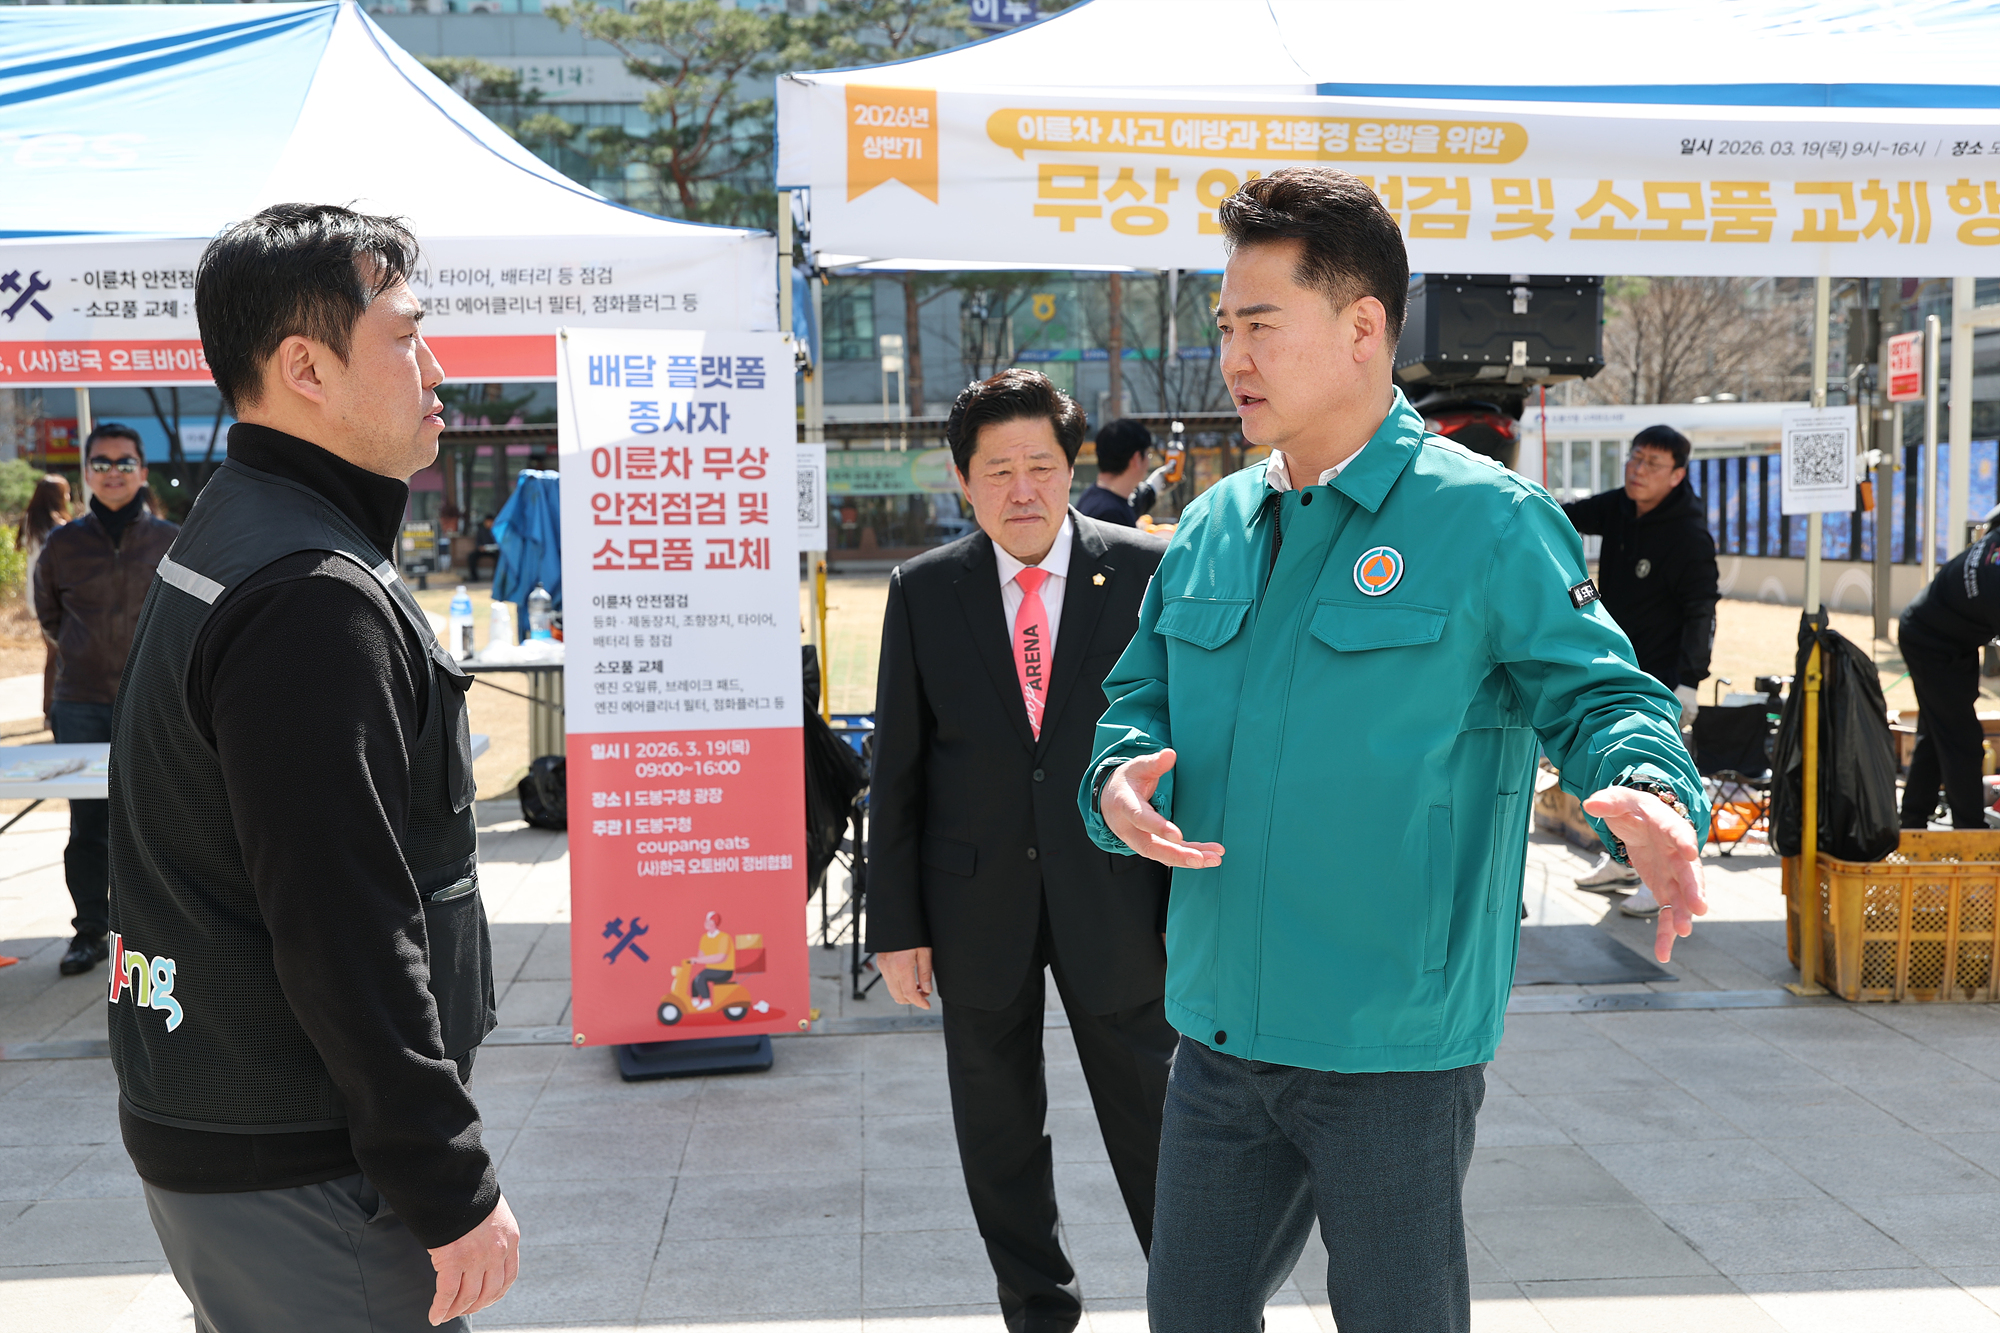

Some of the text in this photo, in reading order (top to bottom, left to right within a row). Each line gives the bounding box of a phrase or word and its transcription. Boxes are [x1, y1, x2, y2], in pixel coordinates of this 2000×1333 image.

[854, 104, 929, 128] 2026년
[1017, 115, 1505, 155] 이륜차 사고 예방과 친환경 운행을 위한
[862, 136, 922, 159] 상반기
[1681, 139, 1713, 155] 일시
[1718, 140, 1764, 155] 2026.
[1770, 141, 1795, 156] 03.
[1803, 141, 1847, 159] 19(목)
[1852, 141, 1926, 157] 9시~16시
[1953, 141, 1983, 156] 장소
[1034, 164, 1179, 236] 무상
[1491, 178, 1554, 241] 및
[1570, 180, 1777, 243] 소모품
[1792, 179, 1931, 243] 교체
[84, 271, 136, 289] 이륜차
[439, 269, 494, 287] 타이어,
[501, 268, 551, 285] 배터리
[557, 268, 572, 285] 등
[580, 267, 612, 285] 점검
[87, 301, 137, 318] 소모품
[144, 301, 177, 318] 교체
[456, 296, 541, 314] 에어클리너
[549, 296, 585, 315] 필터,
[593, 294, 676, 313] 점화플러그
[681, 294, 699, 312] 등
[19, 349, 102, 372] (사)한국
[589, 355, 766, 389] 배달 플랫폼
[629, 401, 730, 434] 종사자
[592, 447, 769, 480] 이륜차 무상
[591, 493, 768, 525] 안전점검 및
[593, 538, 770, 571] 소모품 교체
[593, 595, 688, 609] 이륜차 안전점검
[594, 616, 616, 628] 등화
[628, 615, 679, 628] 제동장치,
[684, 615, 734, 627] 조향장치,
[738, 614, 776, 626] 타이어,
[593, 635, 672, 648] 배터리 등 점검
[595, 660, 663, 674] 소모품 교체
[1023, 624, 1043, 692] ARENA
[595, 679, 743, 694] 엔진 오일류, 브레이크 패드,
[595, 697, 784, 714] 엔진 에어클리너 필터, 점화플러그 등
[591, 743, 620, 760] 일시
[636, 742, 683, 758] 2026.
[686, 741, 702, 756] 3.
[706, 739, 750, 755] 19(목)
[635, 760, 741, 778] 09:00~16:00
[592, 792, 622, 808] 장소
[635, 790, 691, 806] 도봉구청
[694, 788, 723, 804] 광장
[593, 820, 622, 836] 주관
[635, 817, 692, 834] 도봉구청
[637, 836, 750, 855] coupang eats
[637, 854, 793, 877] (사)한국 오토바이 정비협회
